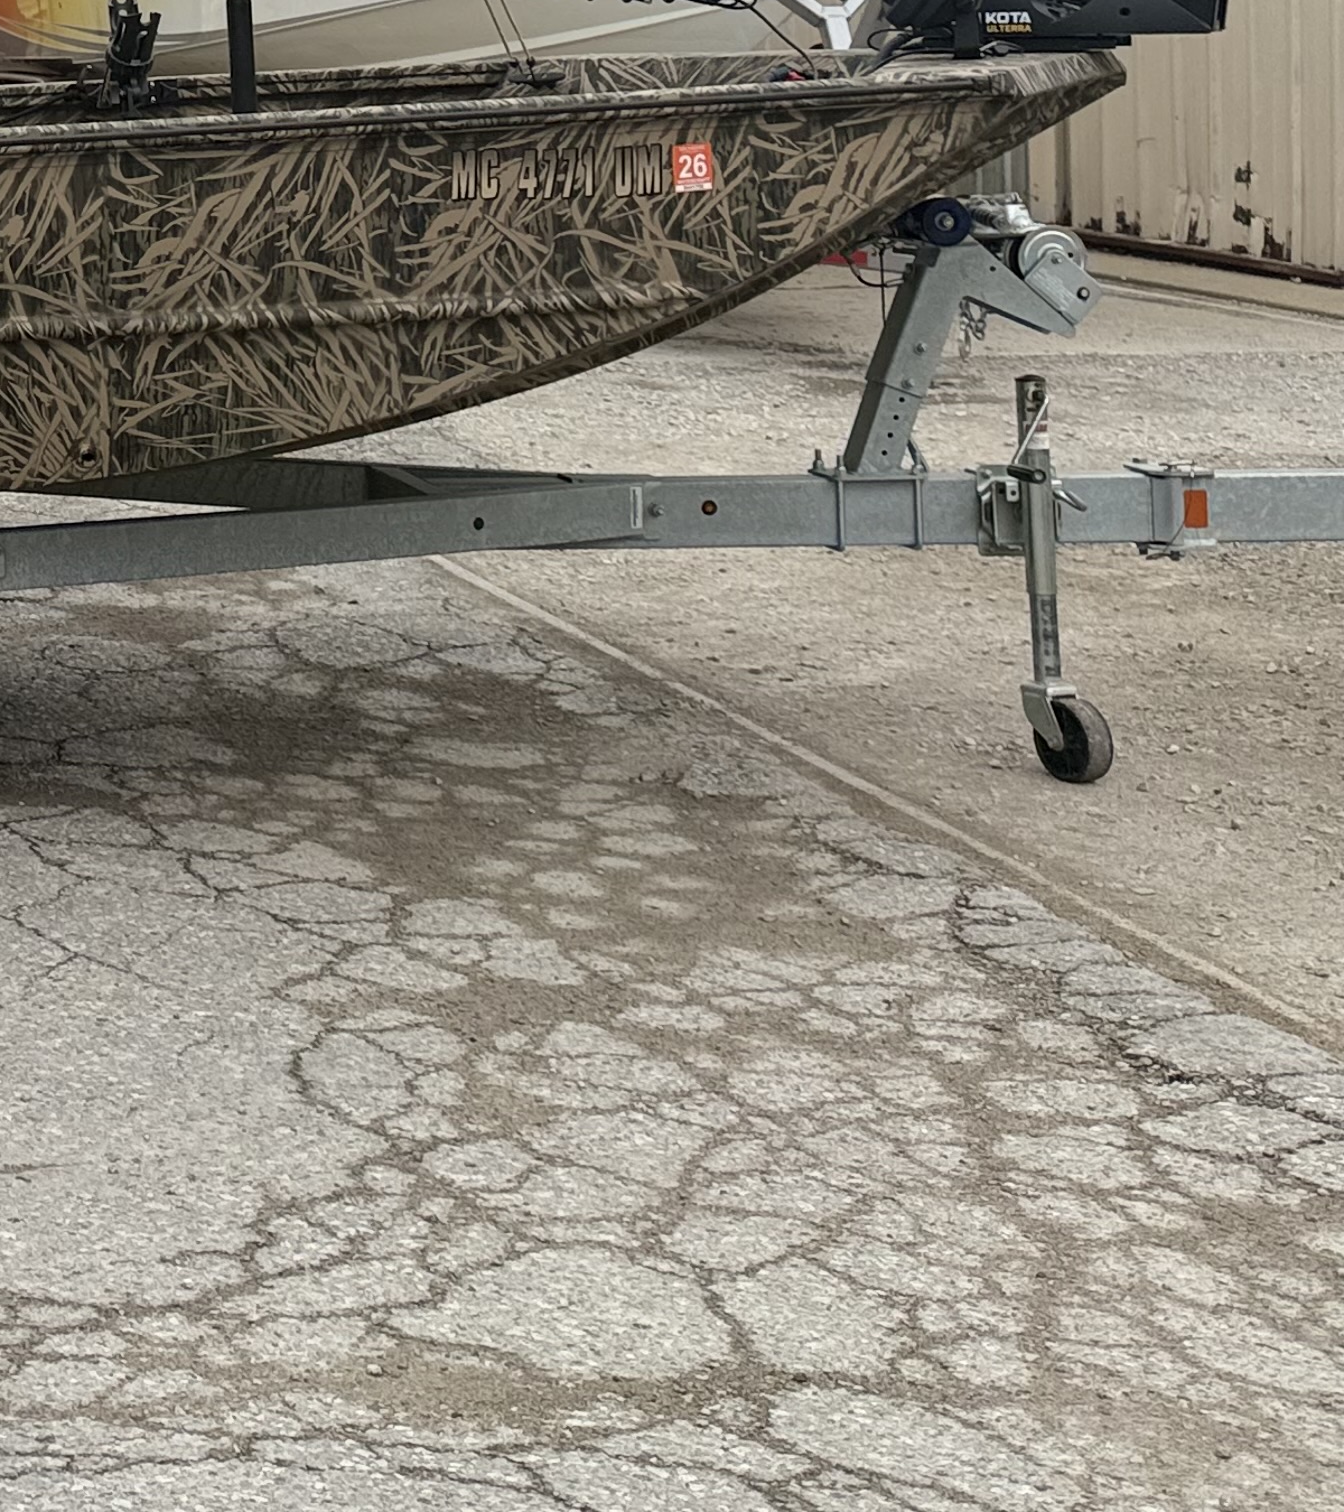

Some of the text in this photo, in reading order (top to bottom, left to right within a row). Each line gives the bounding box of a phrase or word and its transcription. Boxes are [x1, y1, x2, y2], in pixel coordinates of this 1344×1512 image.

[985, 11, 1032, 24] KOTA
[986, 24, 1032, 33] ULTERRA
[451, 143, 662, 201] MC 4771 UM
[678, 152, 708, 179] 26
